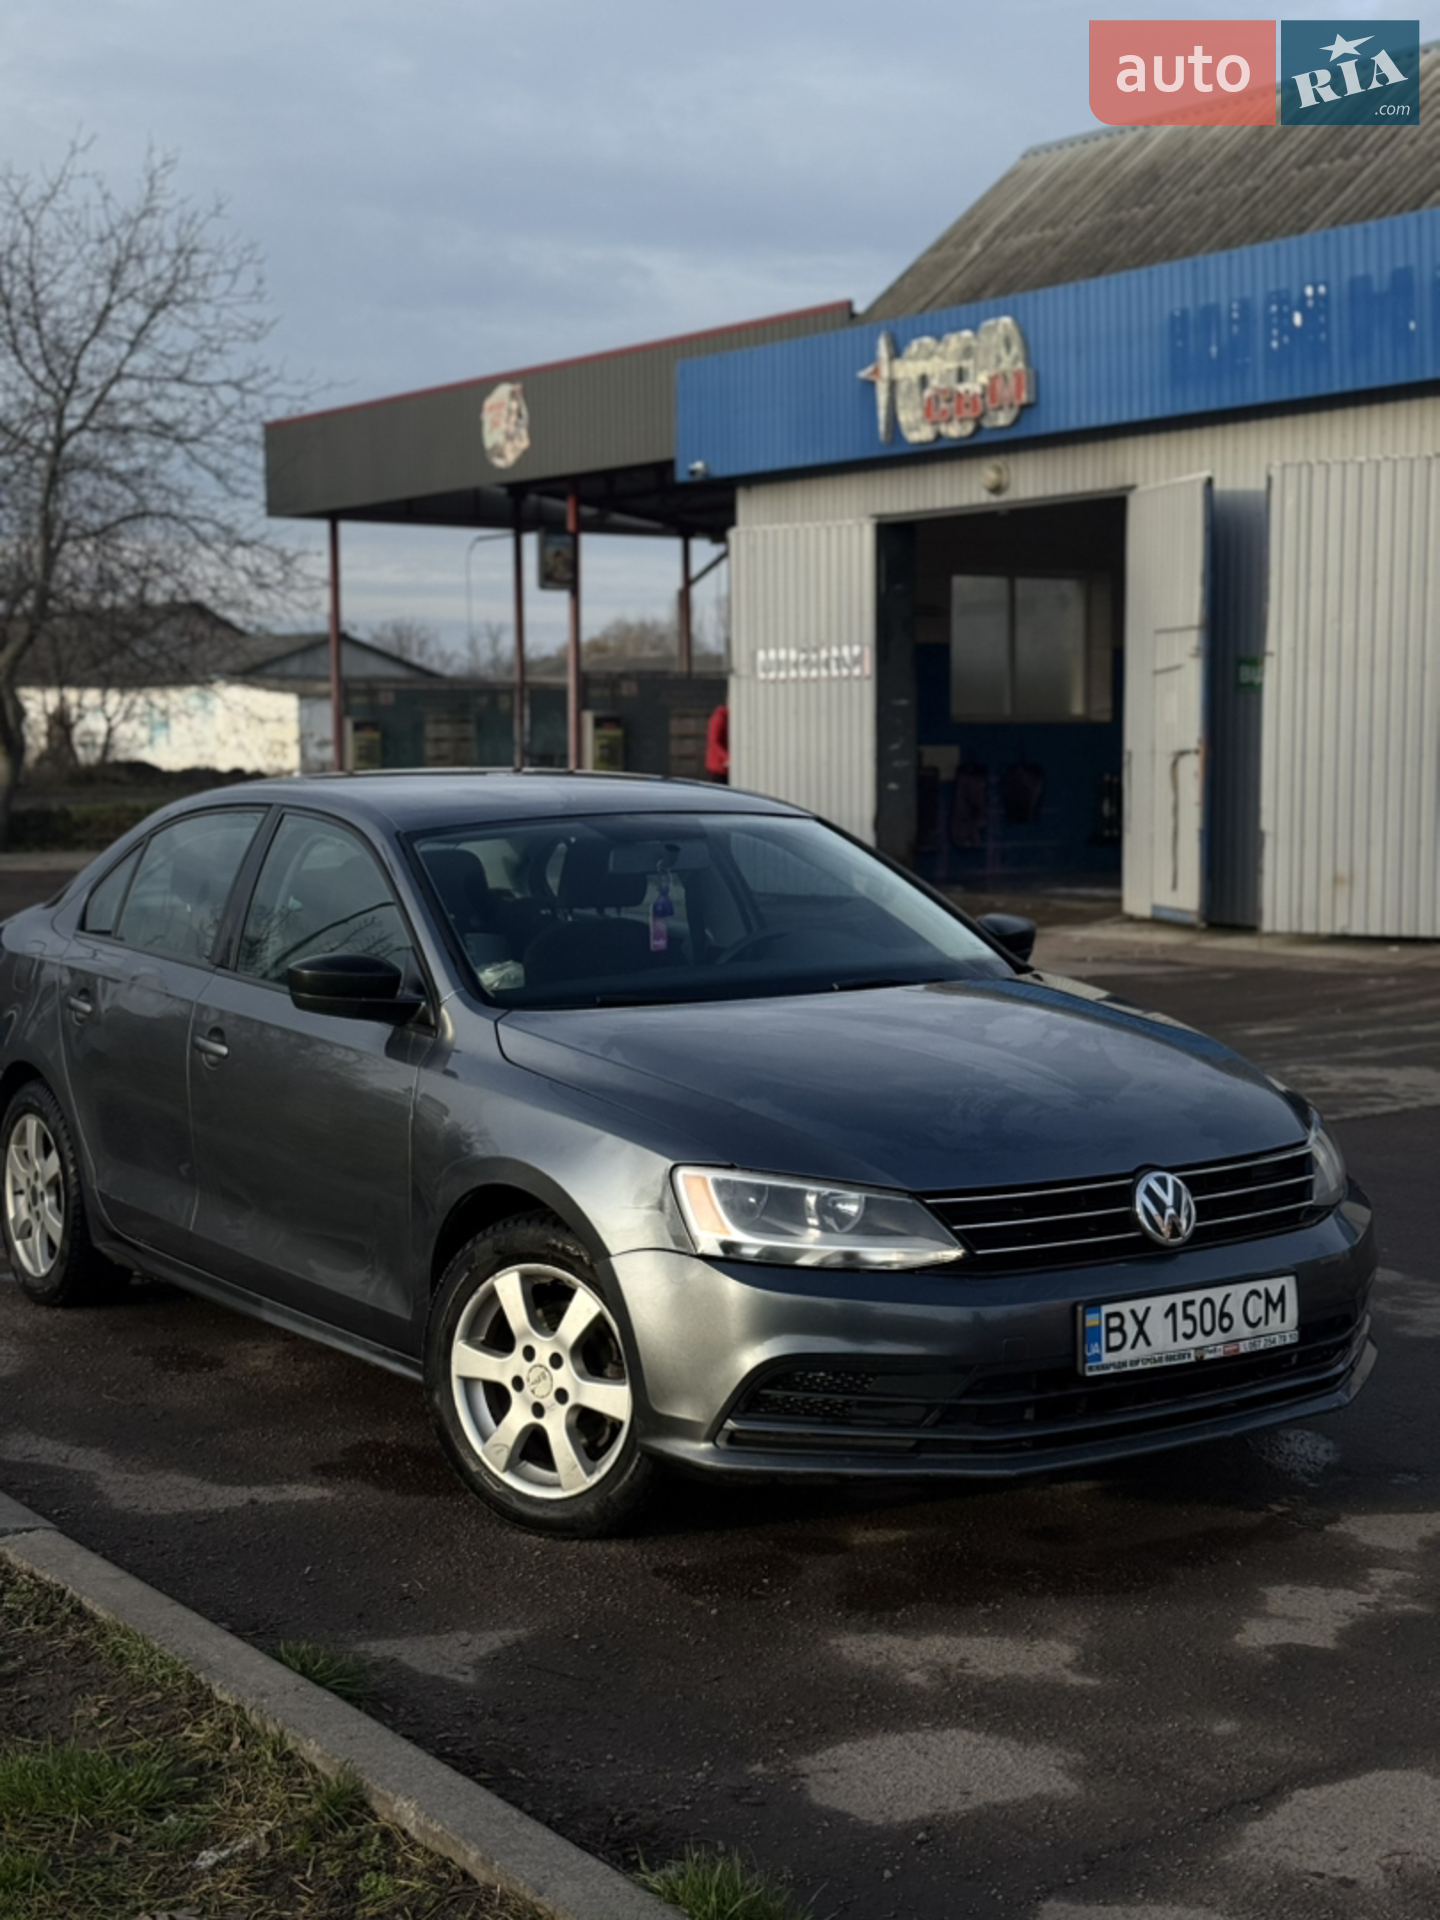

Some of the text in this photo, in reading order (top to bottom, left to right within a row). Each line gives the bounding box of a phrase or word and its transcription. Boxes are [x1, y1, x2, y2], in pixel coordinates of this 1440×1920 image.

[1104, 1284, 1286, 1354] BX 1506 CM
